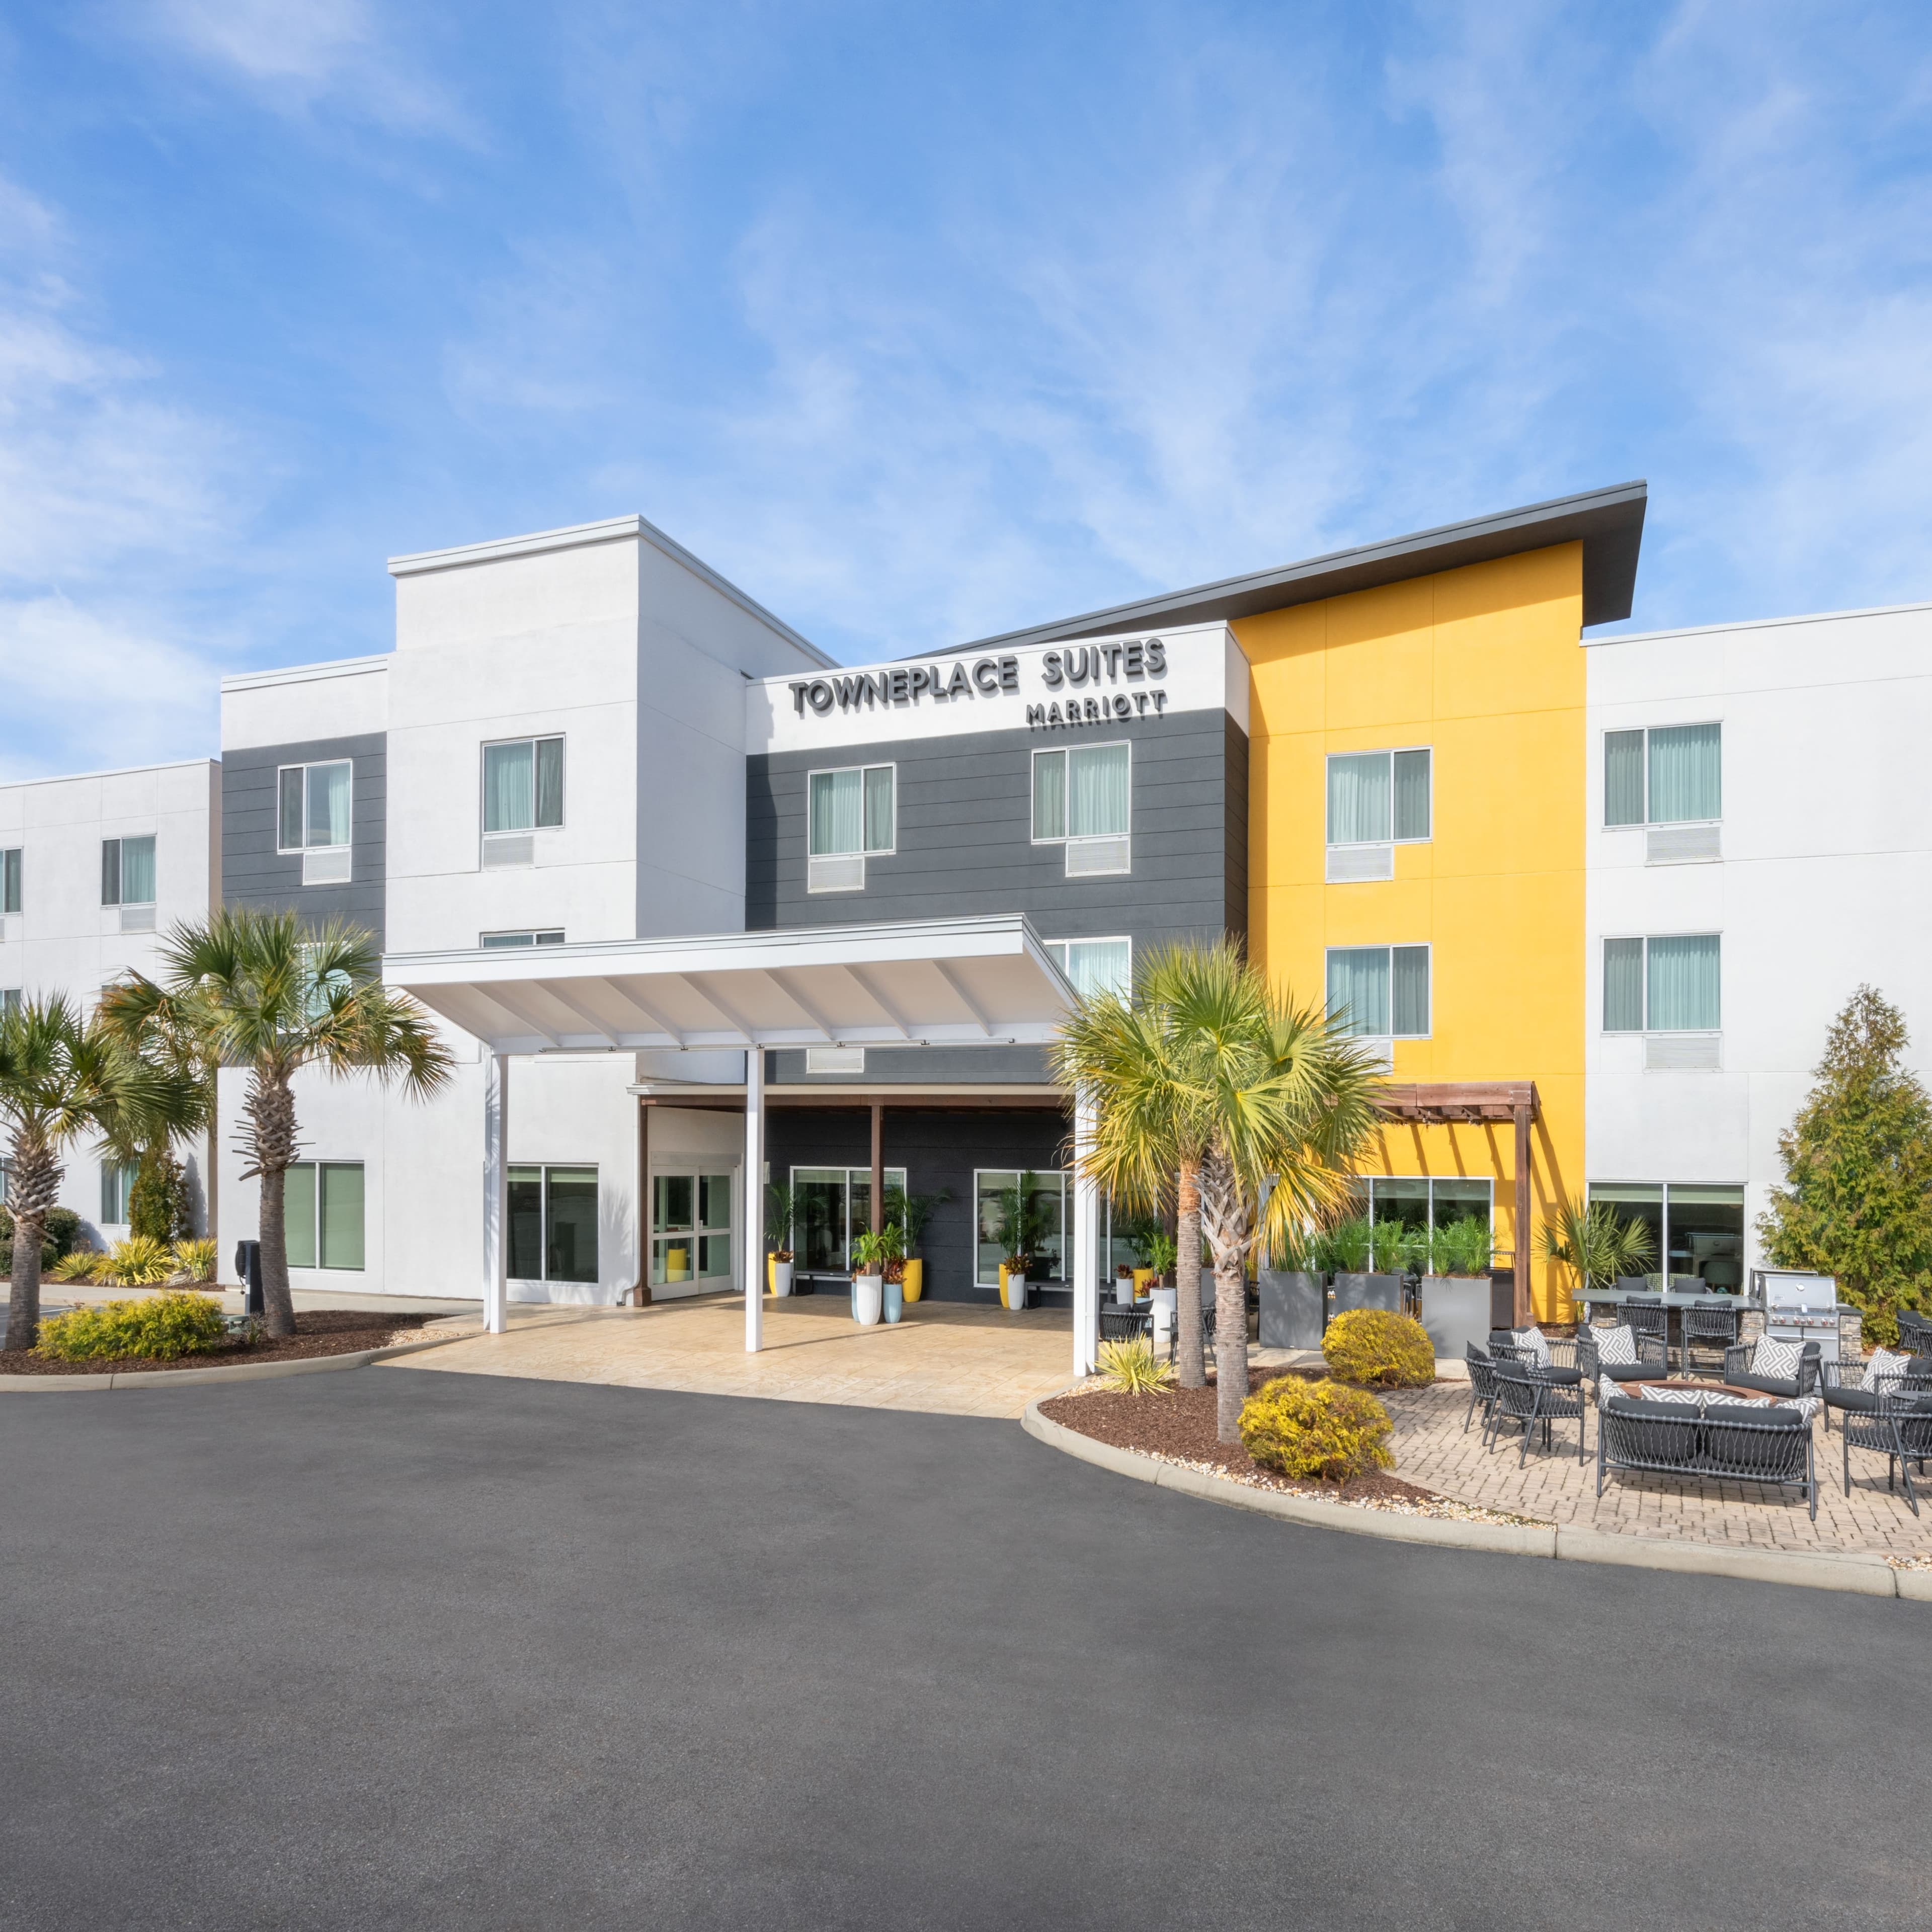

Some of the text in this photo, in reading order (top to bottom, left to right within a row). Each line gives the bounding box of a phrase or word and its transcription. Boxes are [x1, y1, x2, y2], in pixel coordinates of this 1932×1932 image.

[788, 638, 1166, 713] TOWNEPLACE SUITES
[1026, 689, 1166, 725] MARRIOTT
